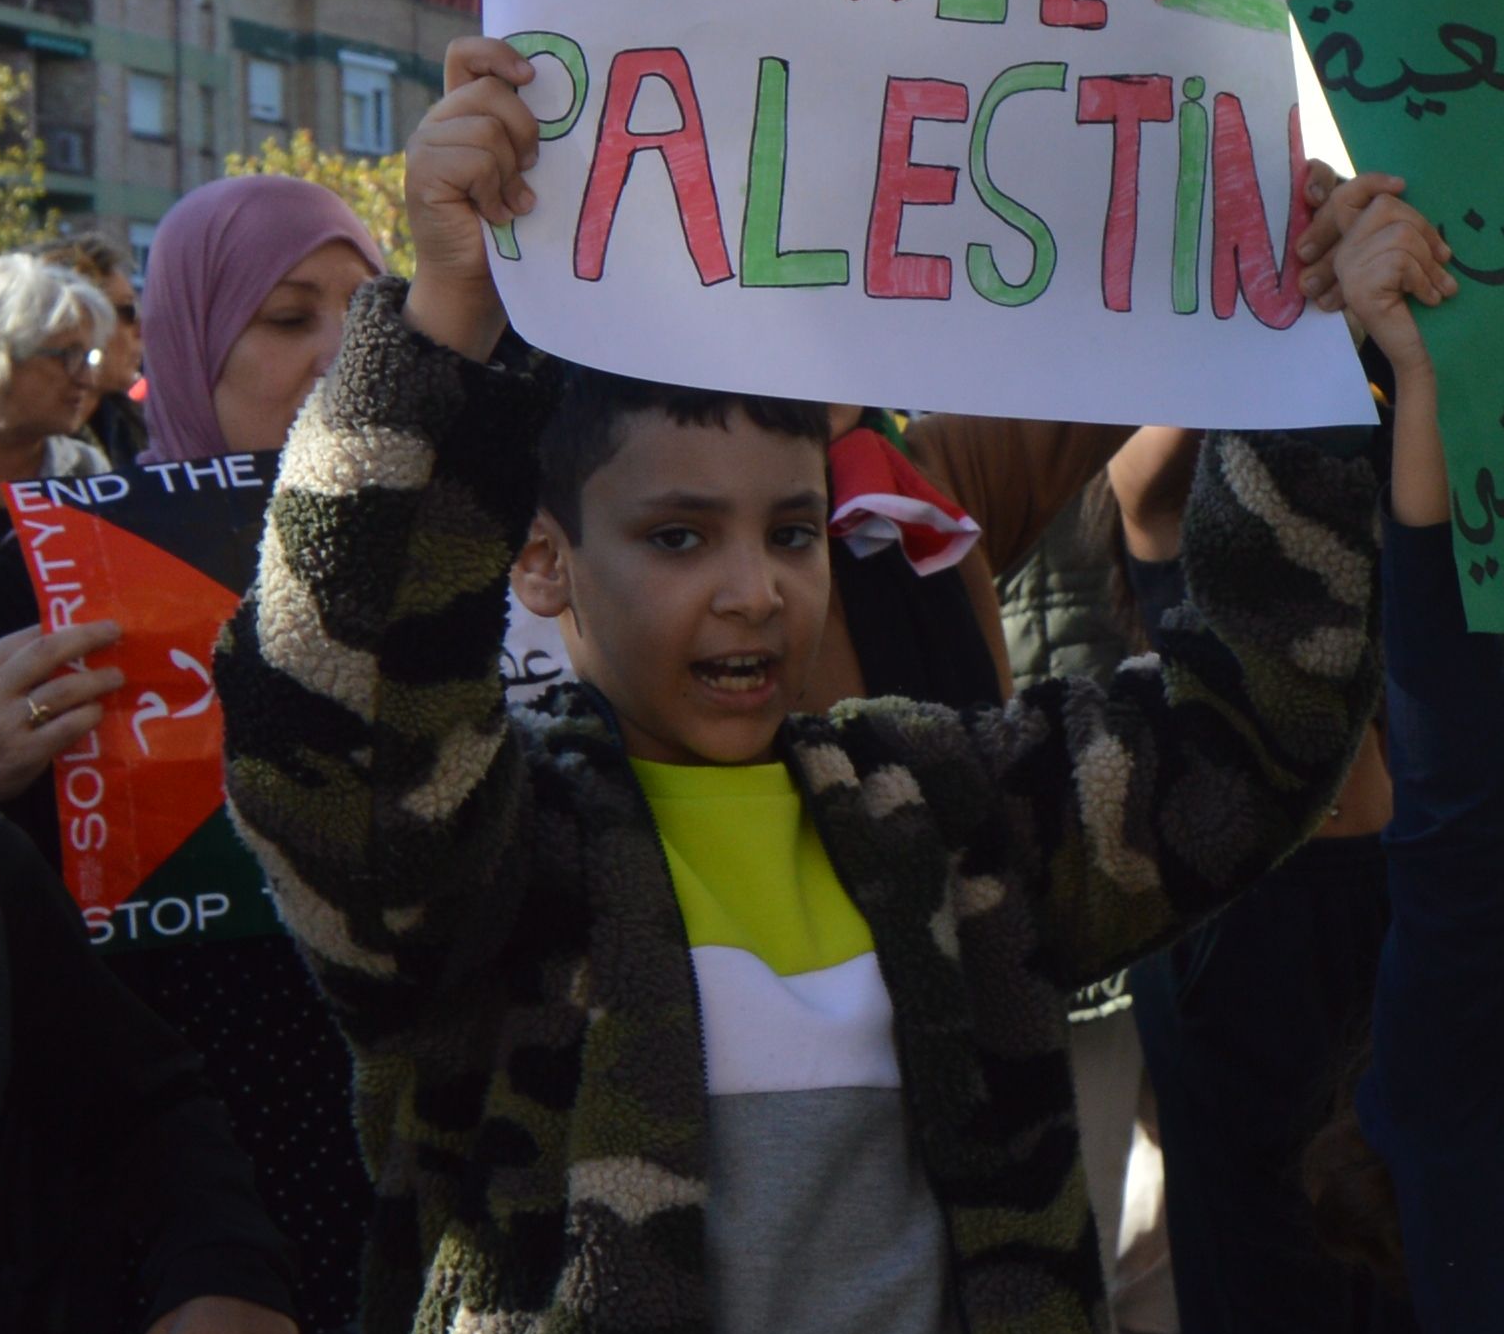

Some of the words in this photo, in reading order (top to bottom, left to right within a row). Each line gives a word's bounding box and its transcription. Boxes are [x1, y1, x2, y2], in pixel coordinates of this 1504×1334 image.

[9, 473, 131, 513] END
[144, 453, 264, 495] THE
[21, 517, 109, 852] SOLRITY
[80, 892, 230, 945] STOP
